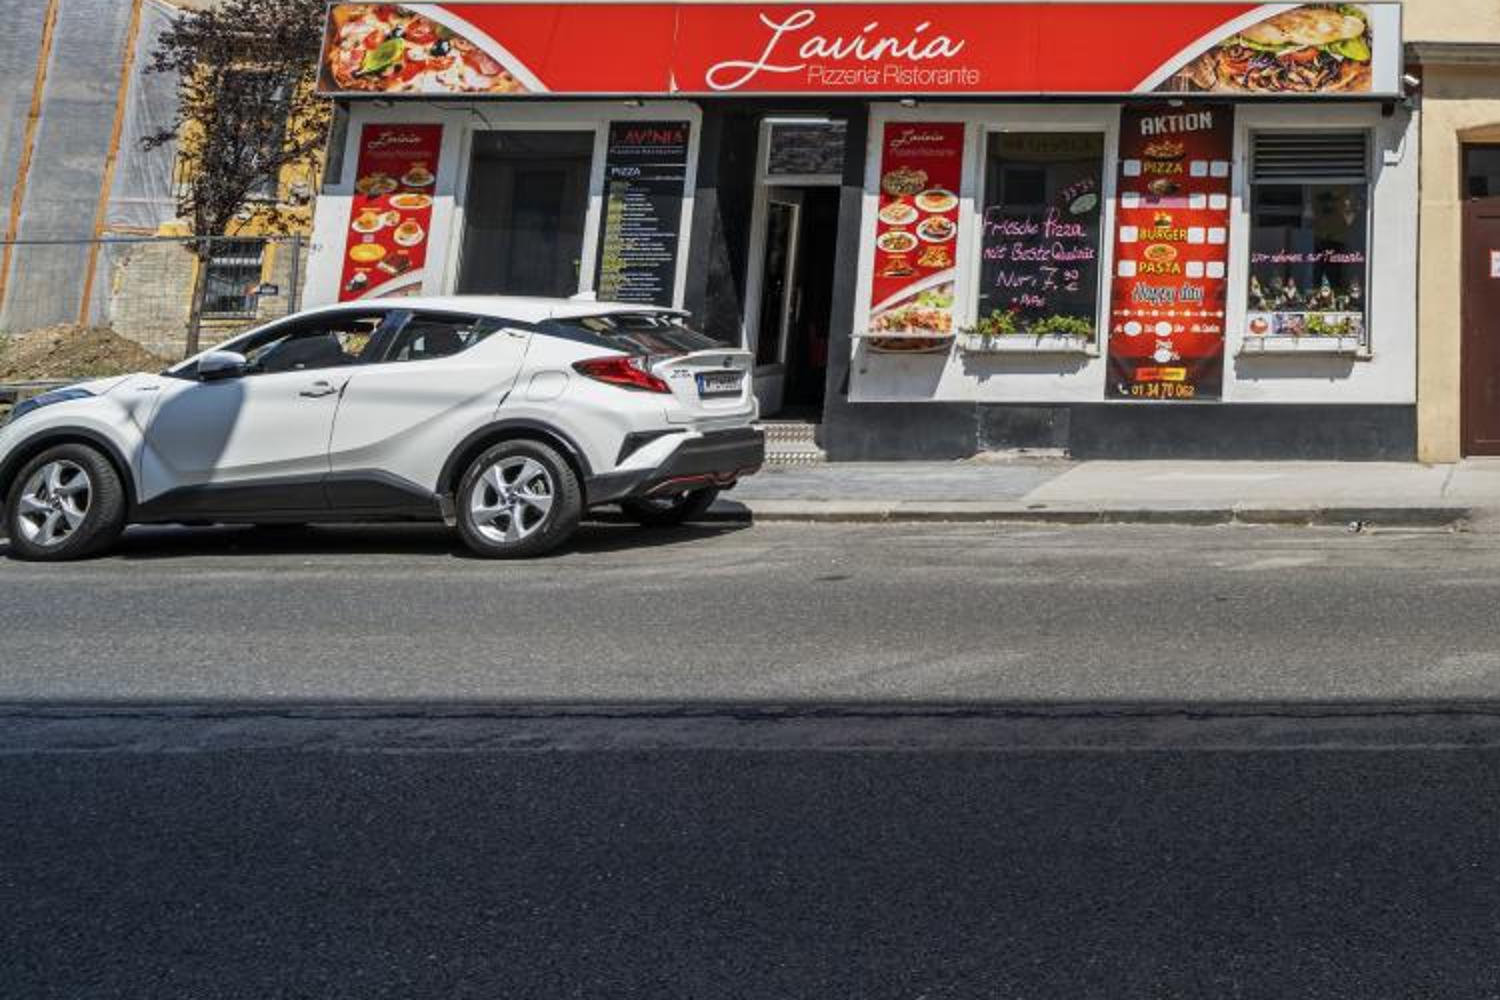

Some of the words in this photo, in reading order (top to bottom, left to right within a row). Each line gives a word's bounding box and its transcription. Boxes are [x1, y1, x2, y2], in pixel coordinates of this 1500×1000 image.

[883, 64, 980, 86] Ristorante
[1140, 111, 1212, 136] AKTION
[611, 167, 641, 177] PIZZA
[1143, 161, 1184, 174] PIZZA
[1042, 207, 1088, 239] Pizza
[1138, 228, 1188, 241] BURGER
[1011, 242, 1051, 261] Beste
[1139, 261, 1181, 275] PASTA
[1131, 384, 1144, 396] 01
[1147, 383, 1159, 397] 34
[1160, 383, 1174, 397] 70
[1175, 384, 1195, 397] 062
